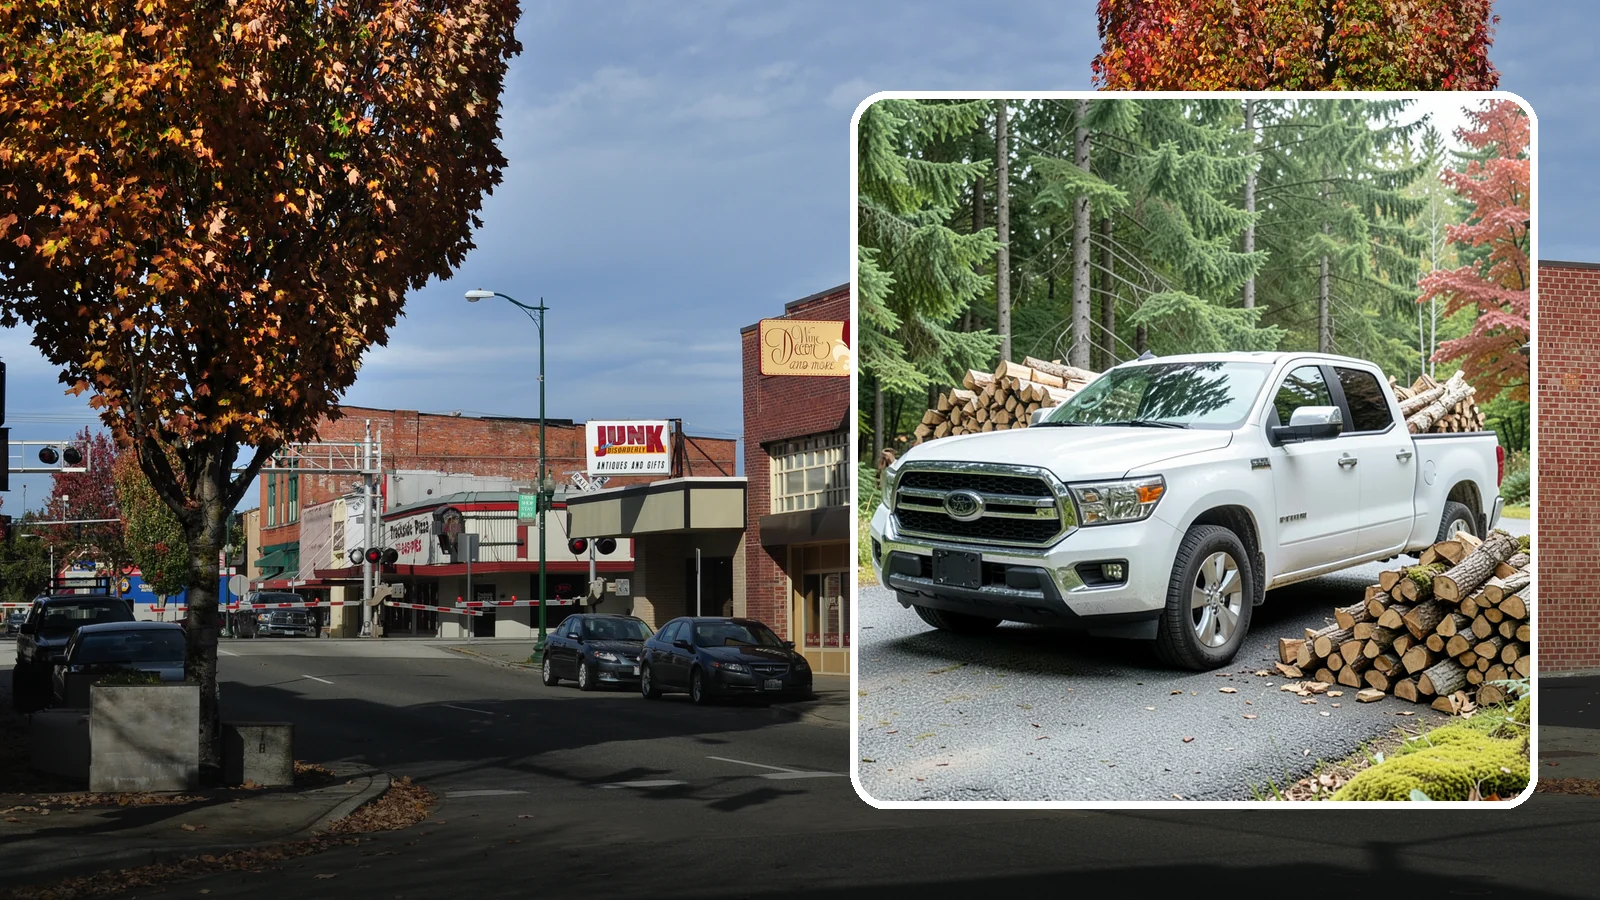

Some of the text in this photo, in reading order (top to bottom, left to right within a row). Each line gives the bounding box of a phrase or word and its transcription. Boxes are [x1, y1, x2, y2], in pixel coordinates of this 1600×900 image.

[765, 328, 830, 365] Decor
[595, 425, 665, 457] JUNK
[607, 446, 646, 454] DISORDERLY
[597, 460, 666, 470] ANTIQUES AND GIFTS
